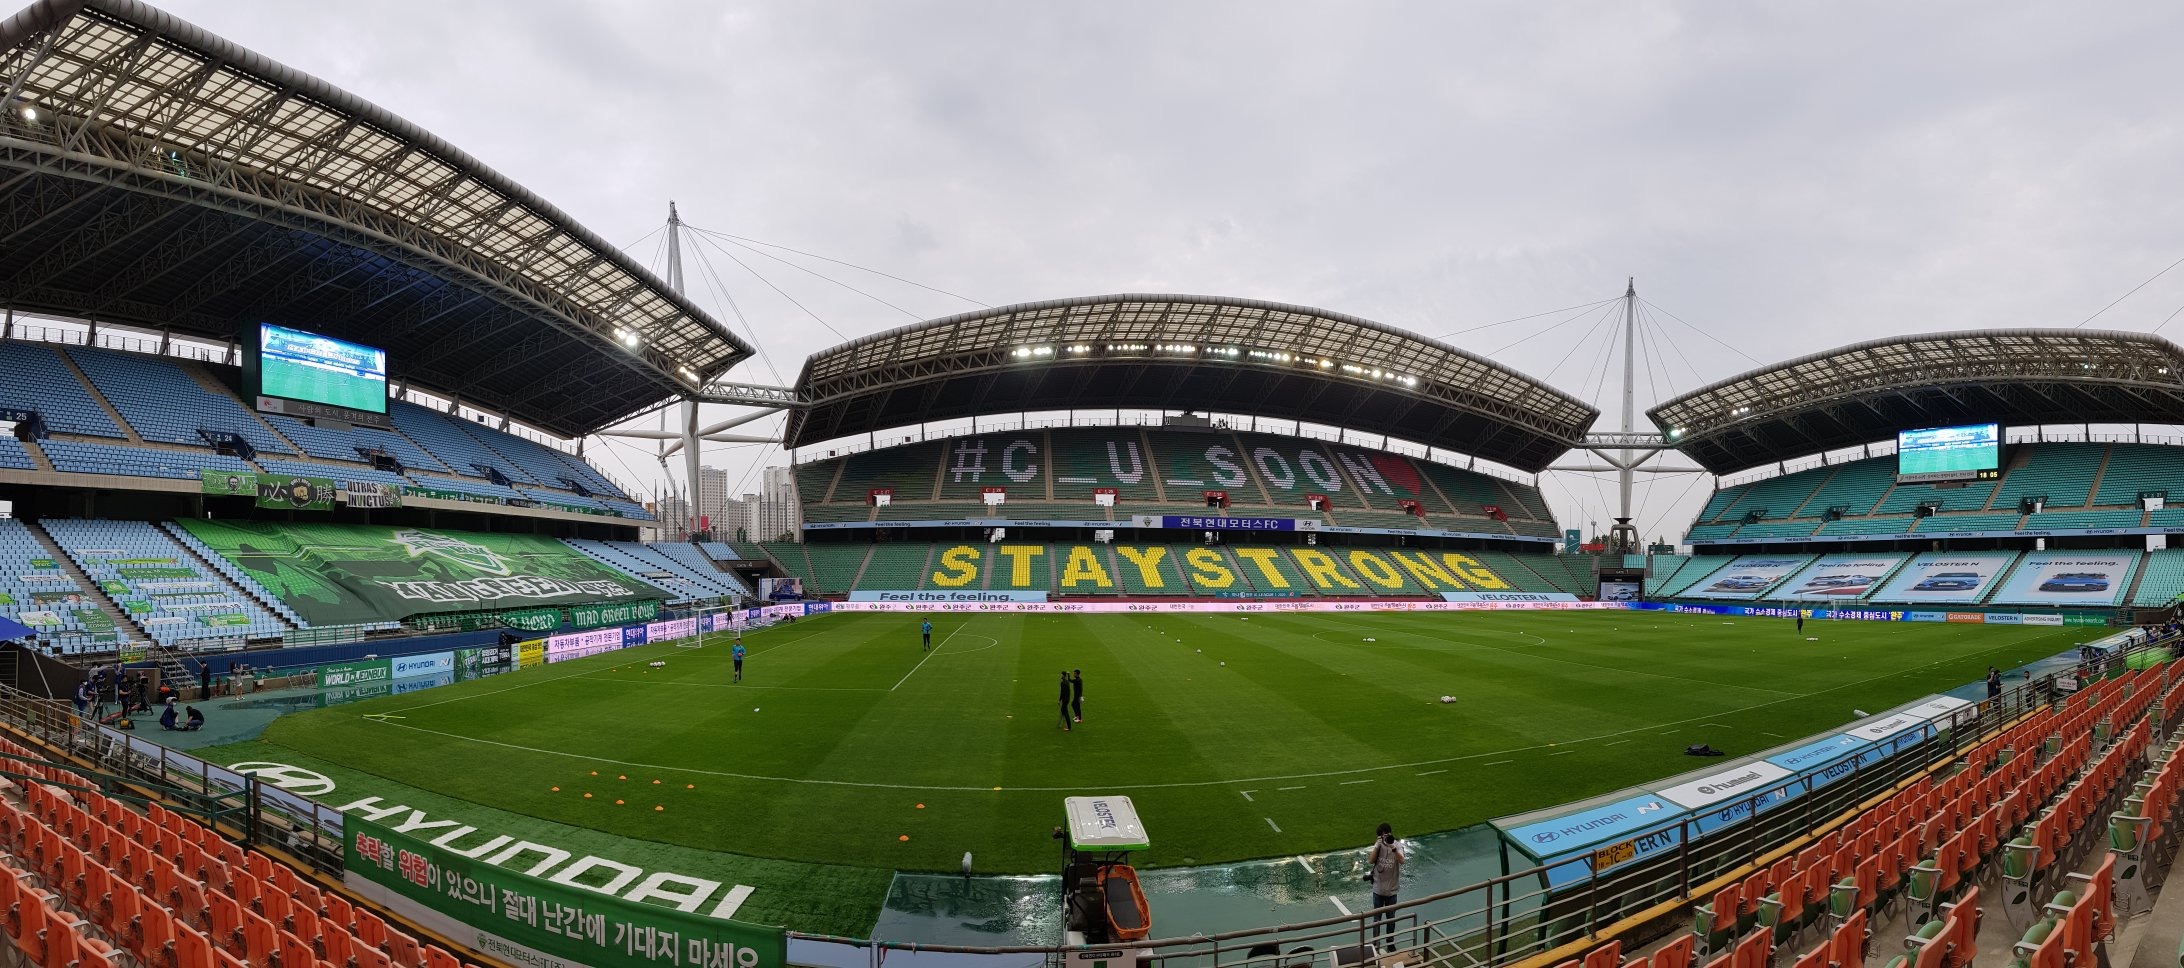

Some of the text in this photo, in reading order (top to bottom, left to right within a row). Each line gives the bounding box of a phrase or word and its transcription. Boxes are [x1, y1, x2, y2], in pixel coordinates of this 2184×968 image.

[314, 483, 334, 505] 勝
[347, 480, 378, 494] ULTRAS
[348, 494, 391, 507] INVICTUS
[879, 592, 1015, 602] Feel the feeling.
[1477, 593, 1536, 601] VELOSTER
[575, 604, 655, 627] MAD GREEN BOYS
[1744, 607, 1755, 615] 국가
[1755, 608, 1776, 616] 수소경제
[1826, 610, 1838, 618] 국가
[1839, 611, 1862, 619] 수소경제
[625, 627, 645, 640] 현대위아
[554, 637, 580, 649] 자동차부품
[408, 660, 436, 670] HYUNDAI
[325, 673, 350, 685] WORLD
[355, 668, 387, 682] JEONBUK
[1709, 771, 1763, 791] hummel
[1734, 795, 1770, 816] HYUDAI
[1092, 800, 1117, 830] VELOSTER
[1560, 813, 1628, 836] HYUNDAI
[1598, 841, 1633, 859] BLOCK
[336, 796, 757, 920] HYUNDAI
[1610, 852, 1621, 864] 1C
[355, 831, 394, 872] 추락할
[398, 849, 442, 892] 위험이
[446, 869, 496, 913] 있으니
[502, 888, 537, 928] 절대
[542, 900, 605, 947] 난간에
[614, 922, 679, 966] 기대지
